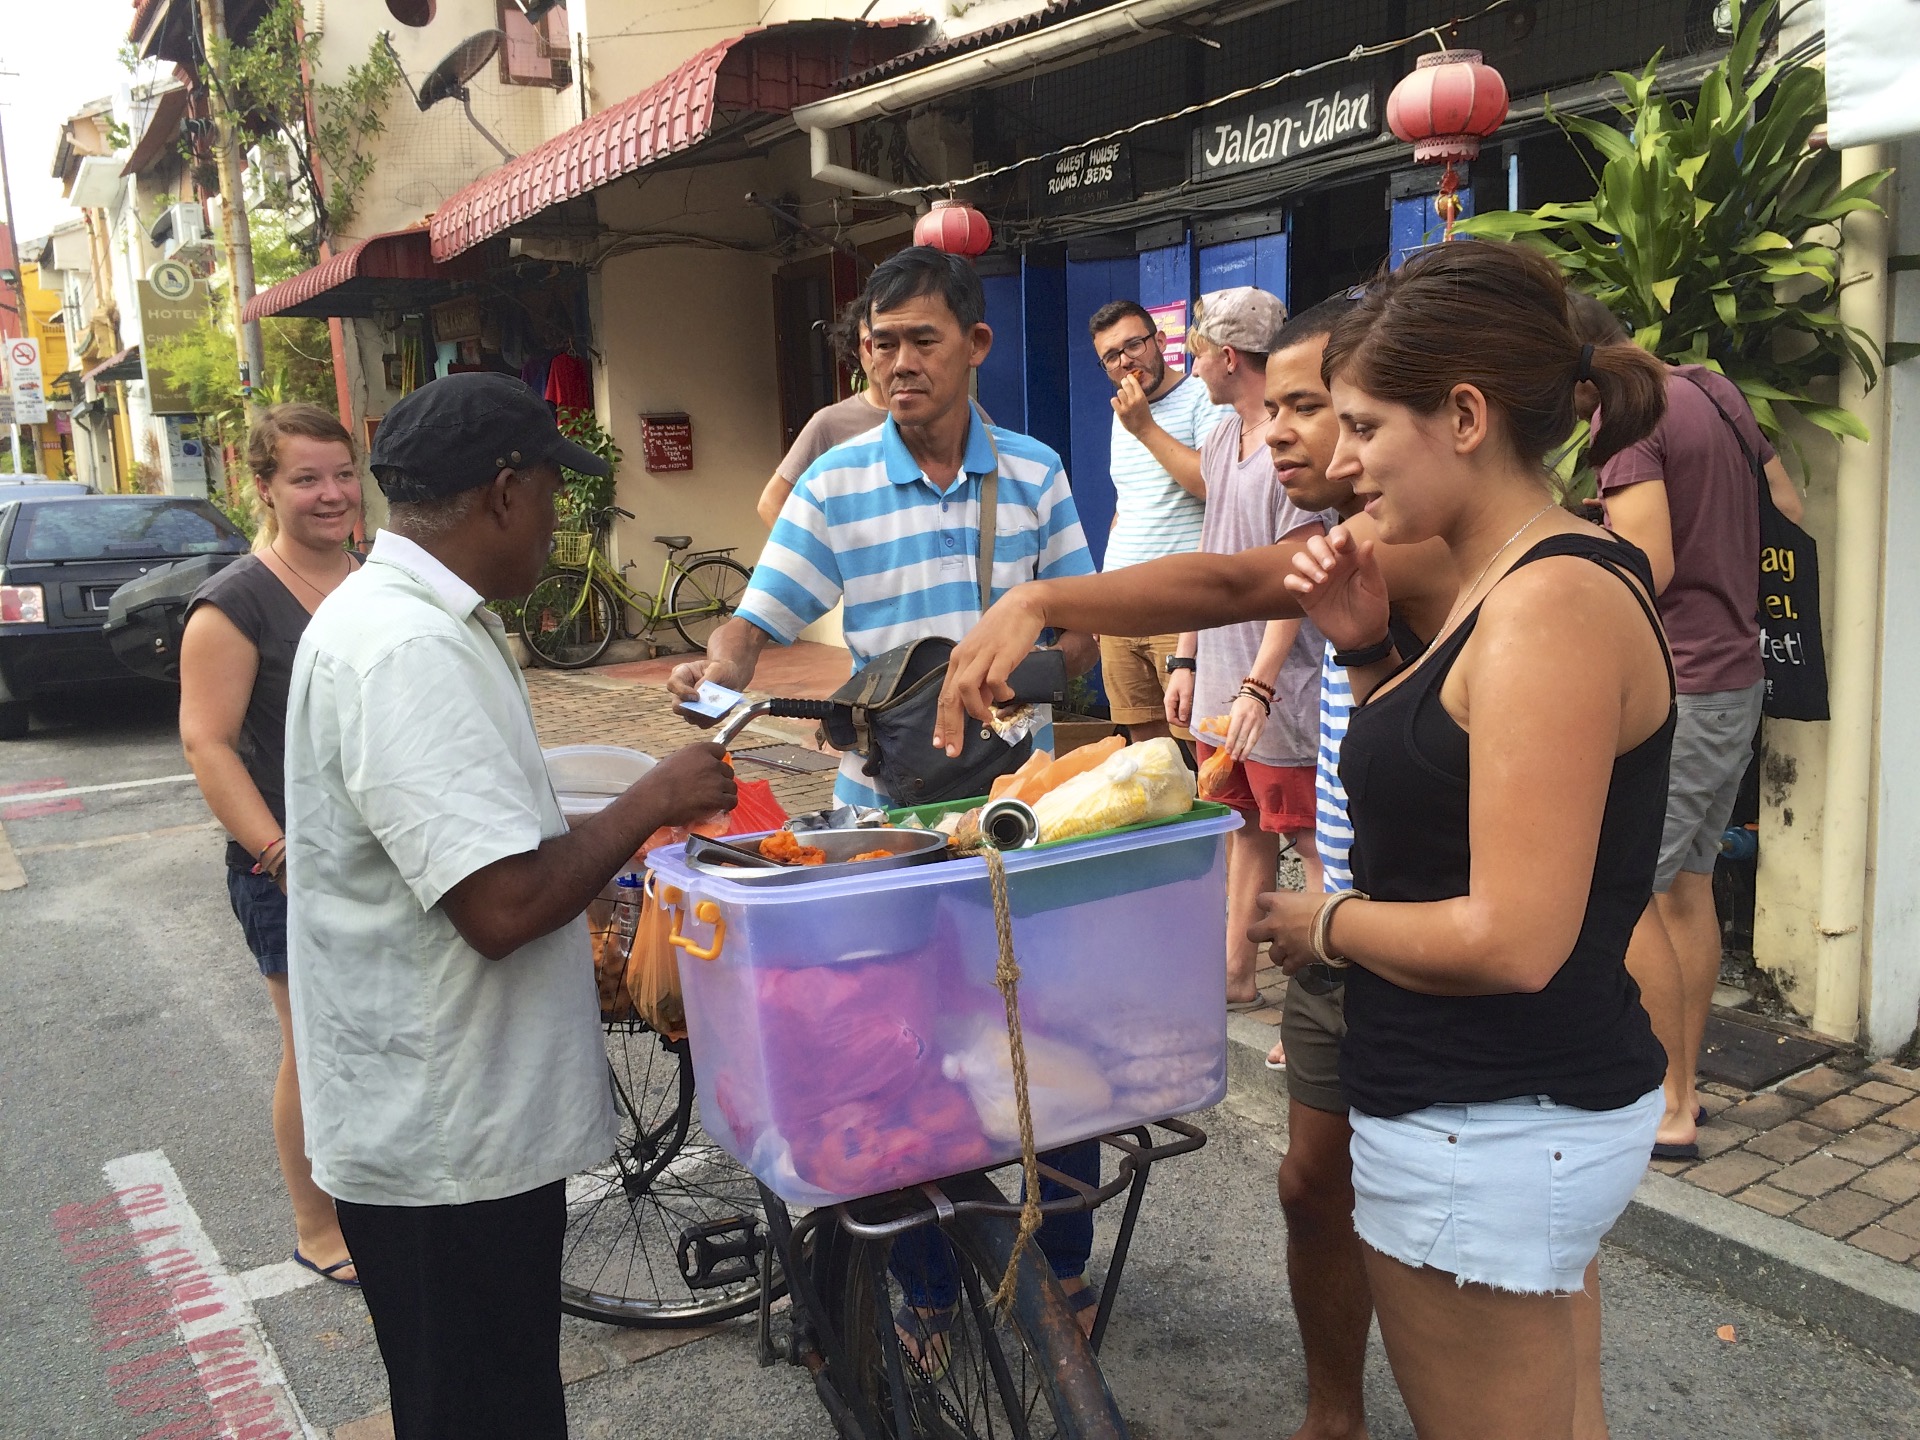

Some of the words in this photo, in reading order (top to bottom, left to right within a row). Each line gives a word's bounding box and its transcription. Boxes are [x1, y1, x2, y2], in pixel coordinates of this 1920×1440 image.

[1206, 90, 1369, 166] Jalan-Jalan
[1056, 152, 1086, 173] GUEST
[1089, 143, 1121, 167] HOUSE
[1047, 164, 1113, 195] ROOMS/BEDS
[148, 309, 199, 319] HOTEL
